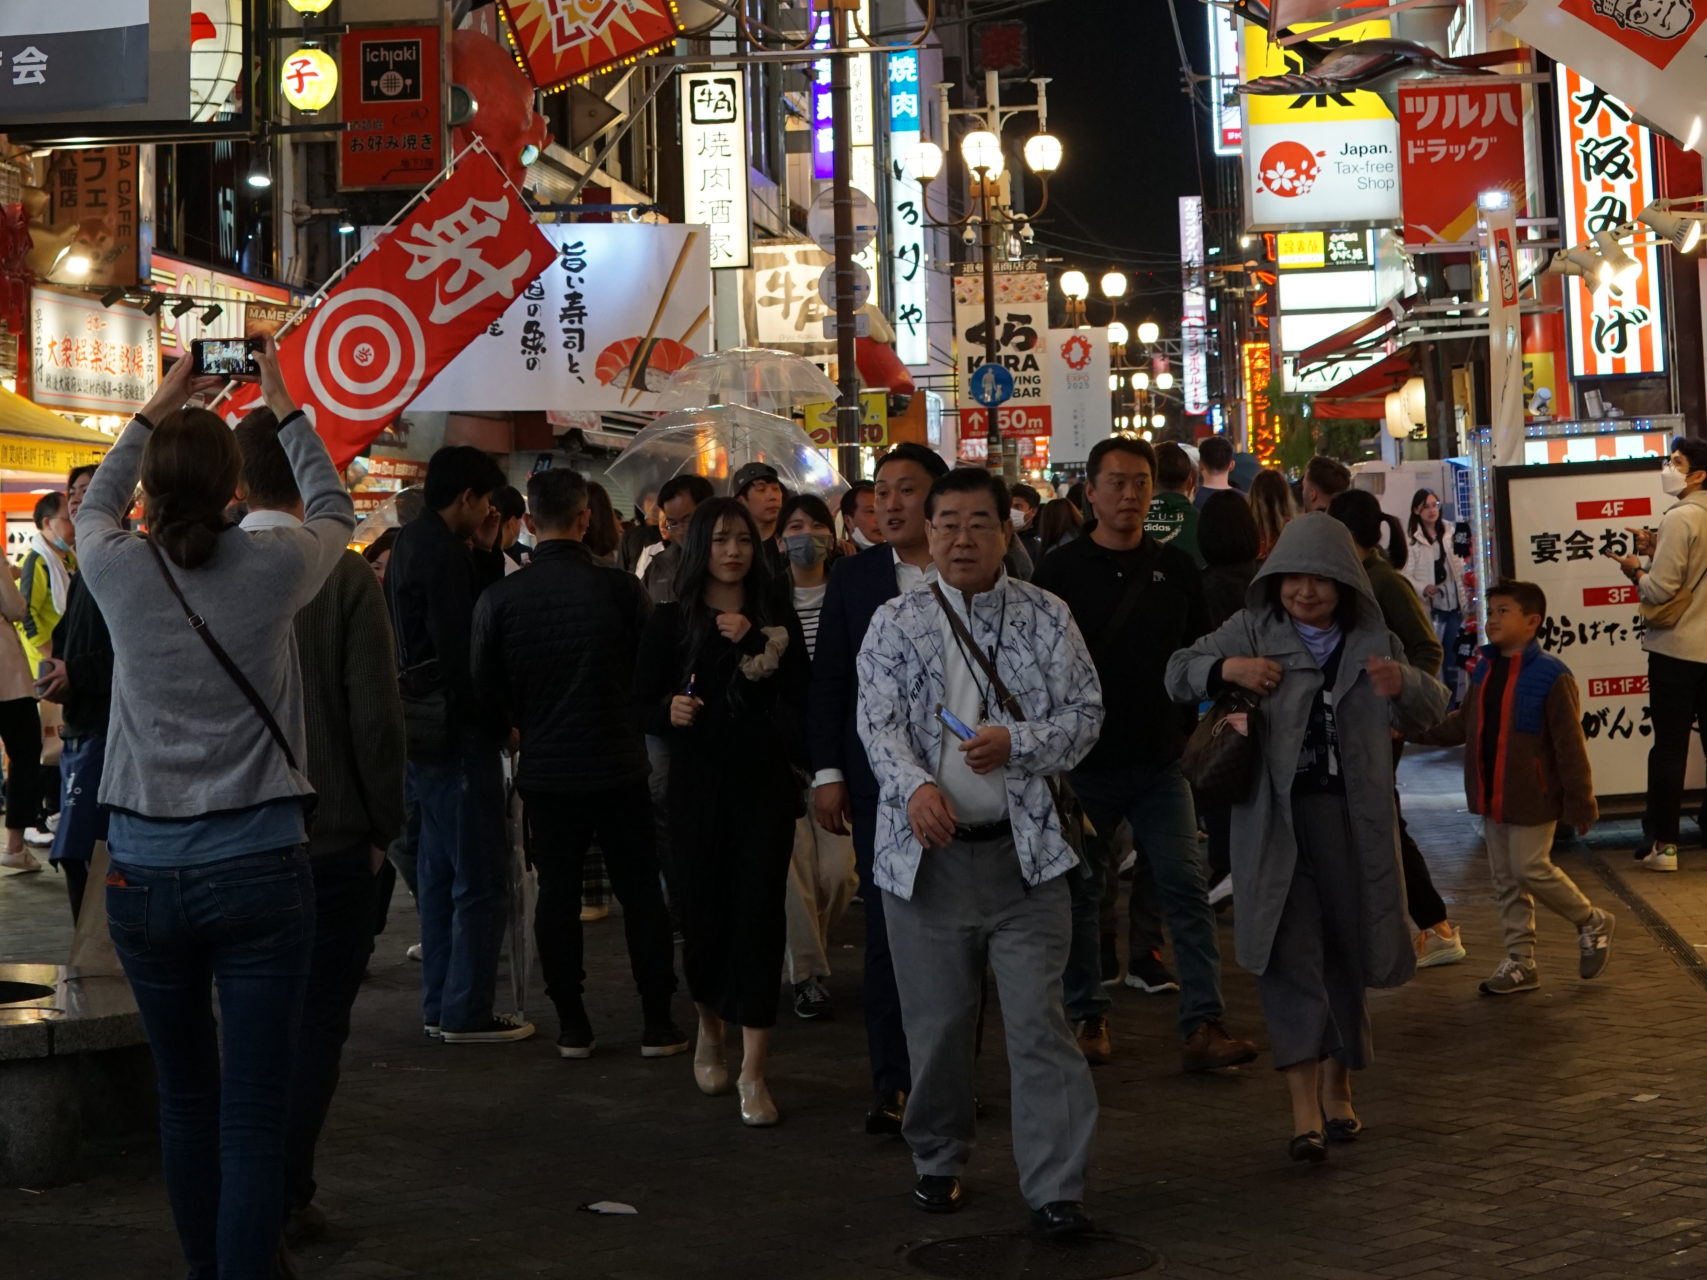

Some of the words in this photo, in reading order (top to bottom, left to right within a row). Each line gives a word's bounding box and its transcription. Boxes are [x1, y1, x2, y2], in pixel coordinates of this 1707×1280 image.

[888, 56, 919, 118] 焼肉
[697, 89, 732, 115] 牛角
[1404, 92, 1519, 132] ツルハ
[351, 134, 433, 153] お好み焼き
[1339, 142, 1393, 157] Japan.
[1407, 136, 1498, 165] ドラッグ
[1334, 160, 1394, 174] Tax-free
[697, 131, 733, 261] 焼肉酒家
[1357, 177, 1395, 192] Shop
[118, 180, 131, 237] CAFE
[1576, 84, 1649, 355] 大阪みげ
[758, 271, 836, 332] 牛角
[965, 312, 1038, 352] くら
[984, 410, 1043, 430] 50m
[1601, 501, 1625, 517] 4F
[1530, 525, 1658, 564] 宴会お
[1608, 588, 1631, 603] 3F
